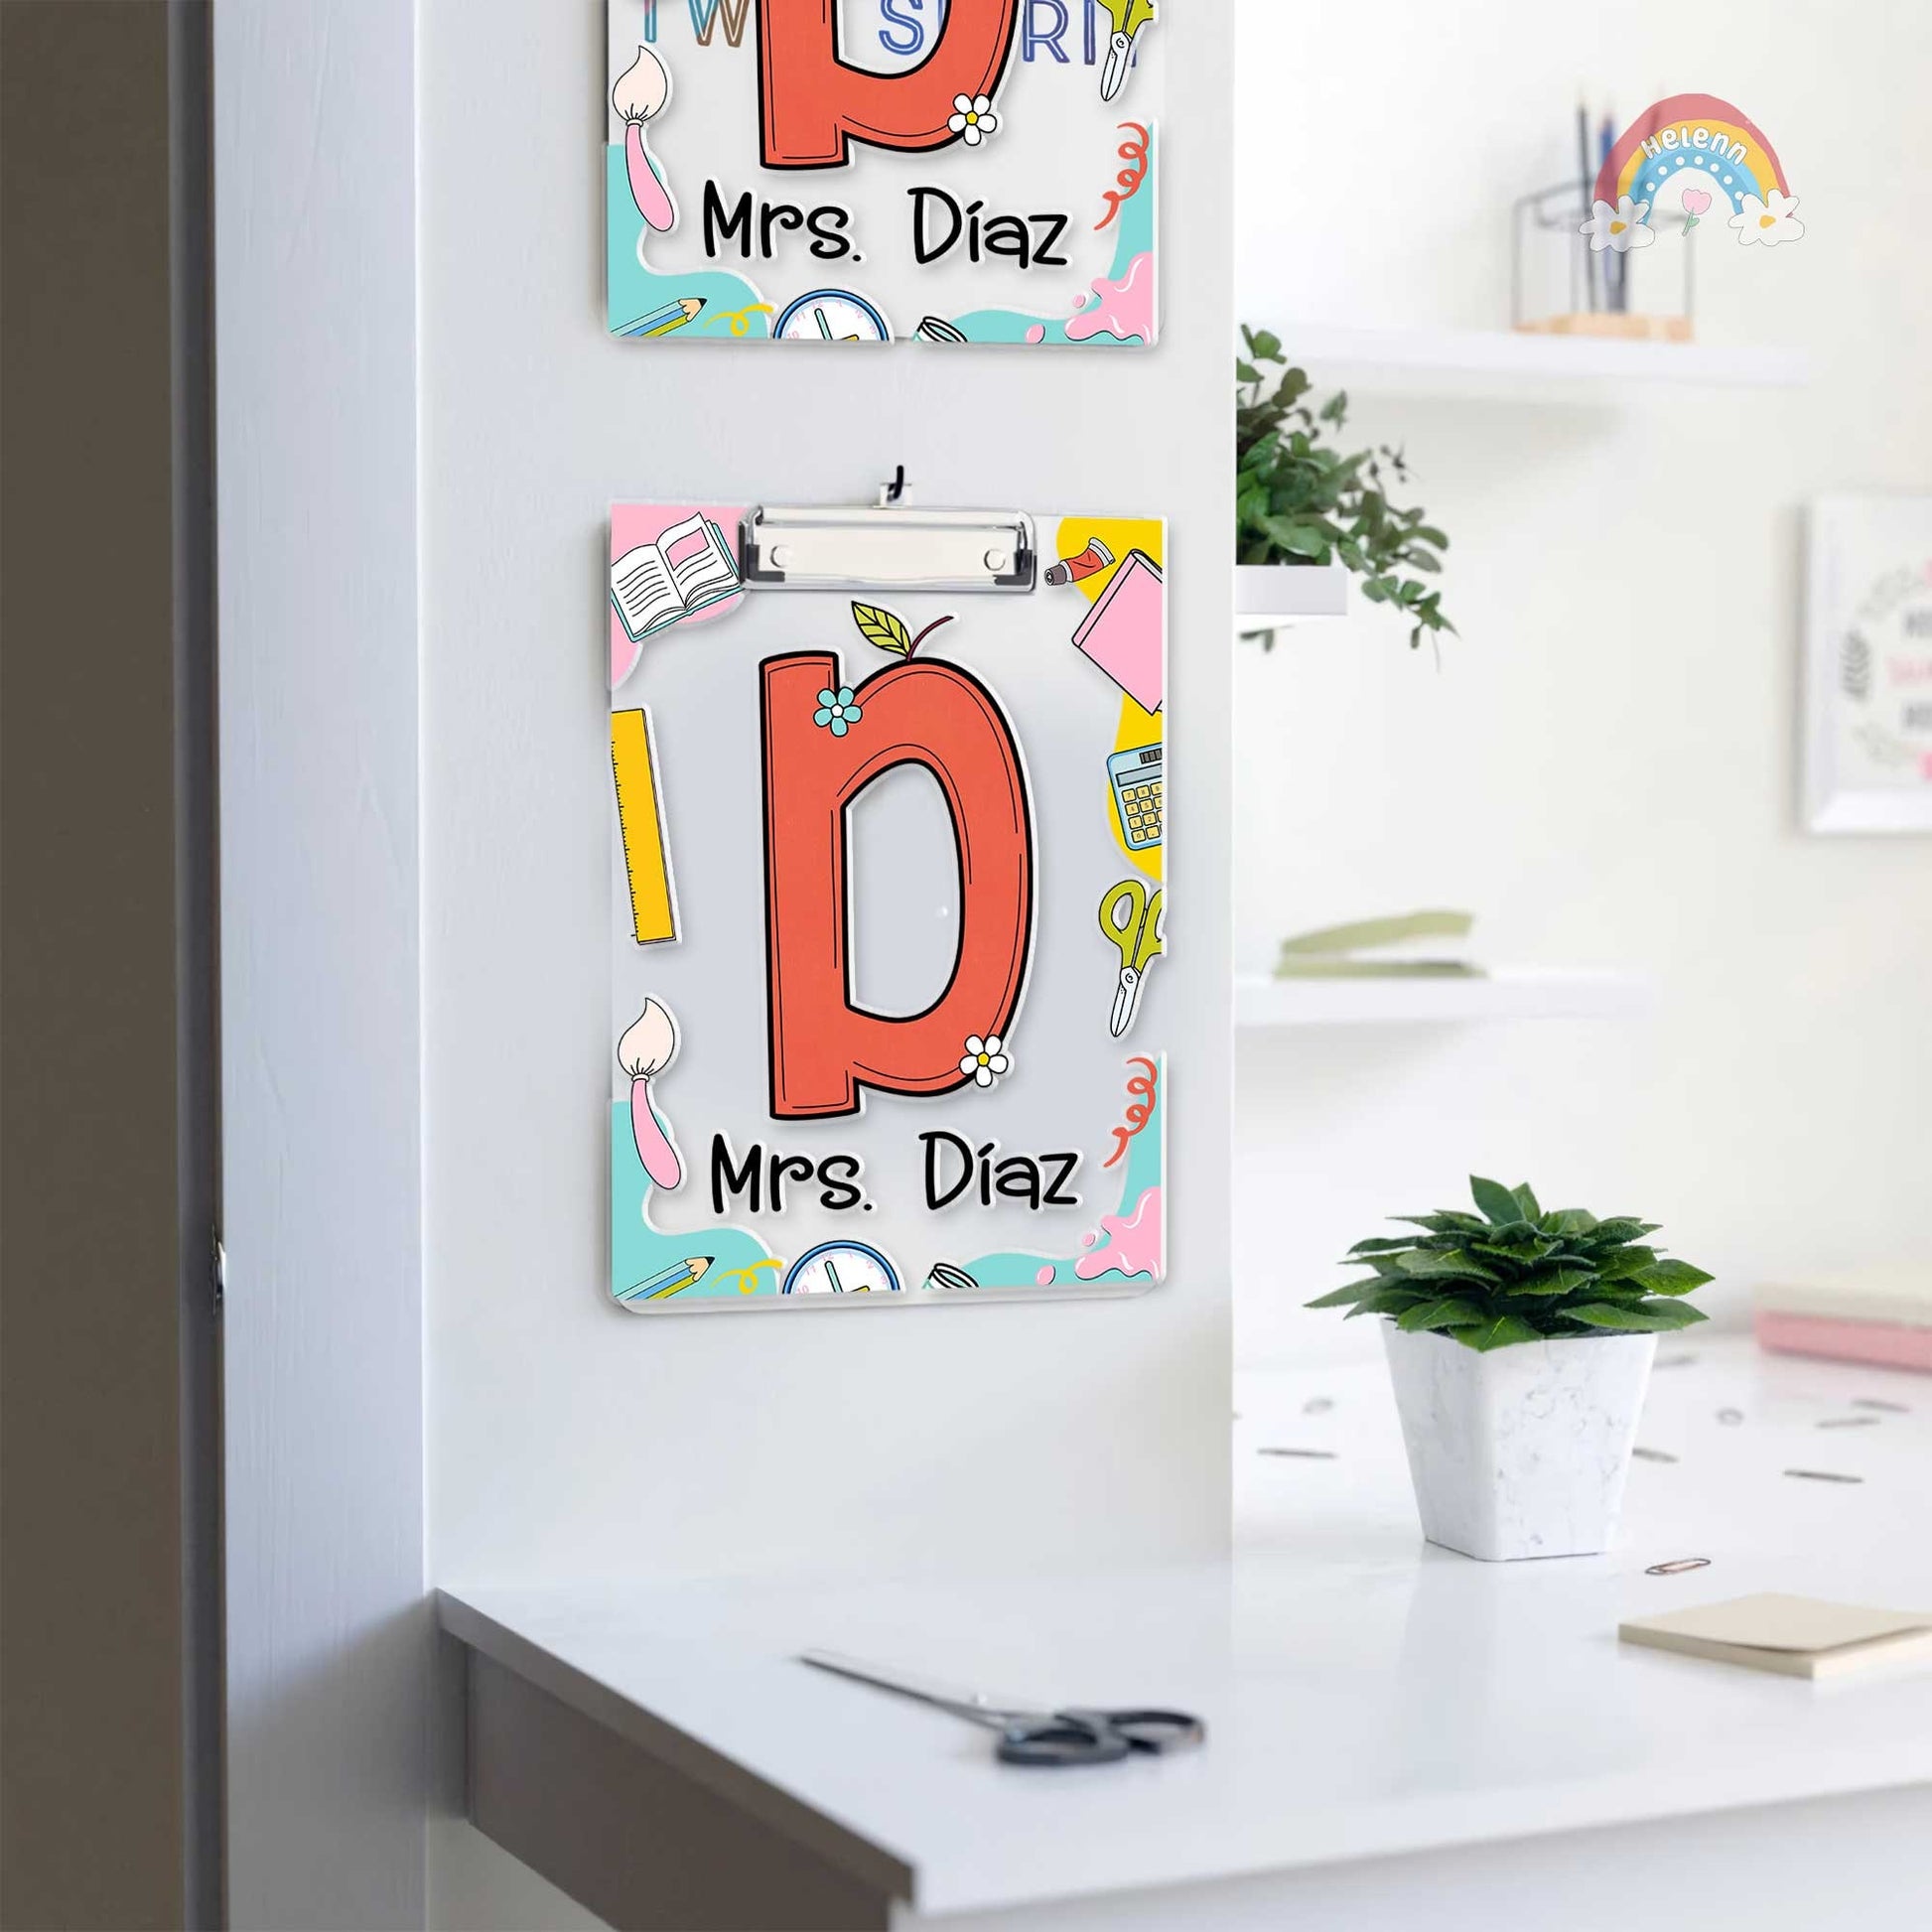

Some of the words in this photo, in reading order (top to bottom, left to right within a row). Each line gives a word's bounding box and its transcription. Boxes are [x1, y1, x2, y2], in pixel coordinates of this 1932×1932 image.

[704, 180, 862, 262] Mrs.
[907, 187, 1068, 269] Díaz
[712, 1133, 873, 1213] Mrs.
[918, 1131, 1078, 1210] Díaz
